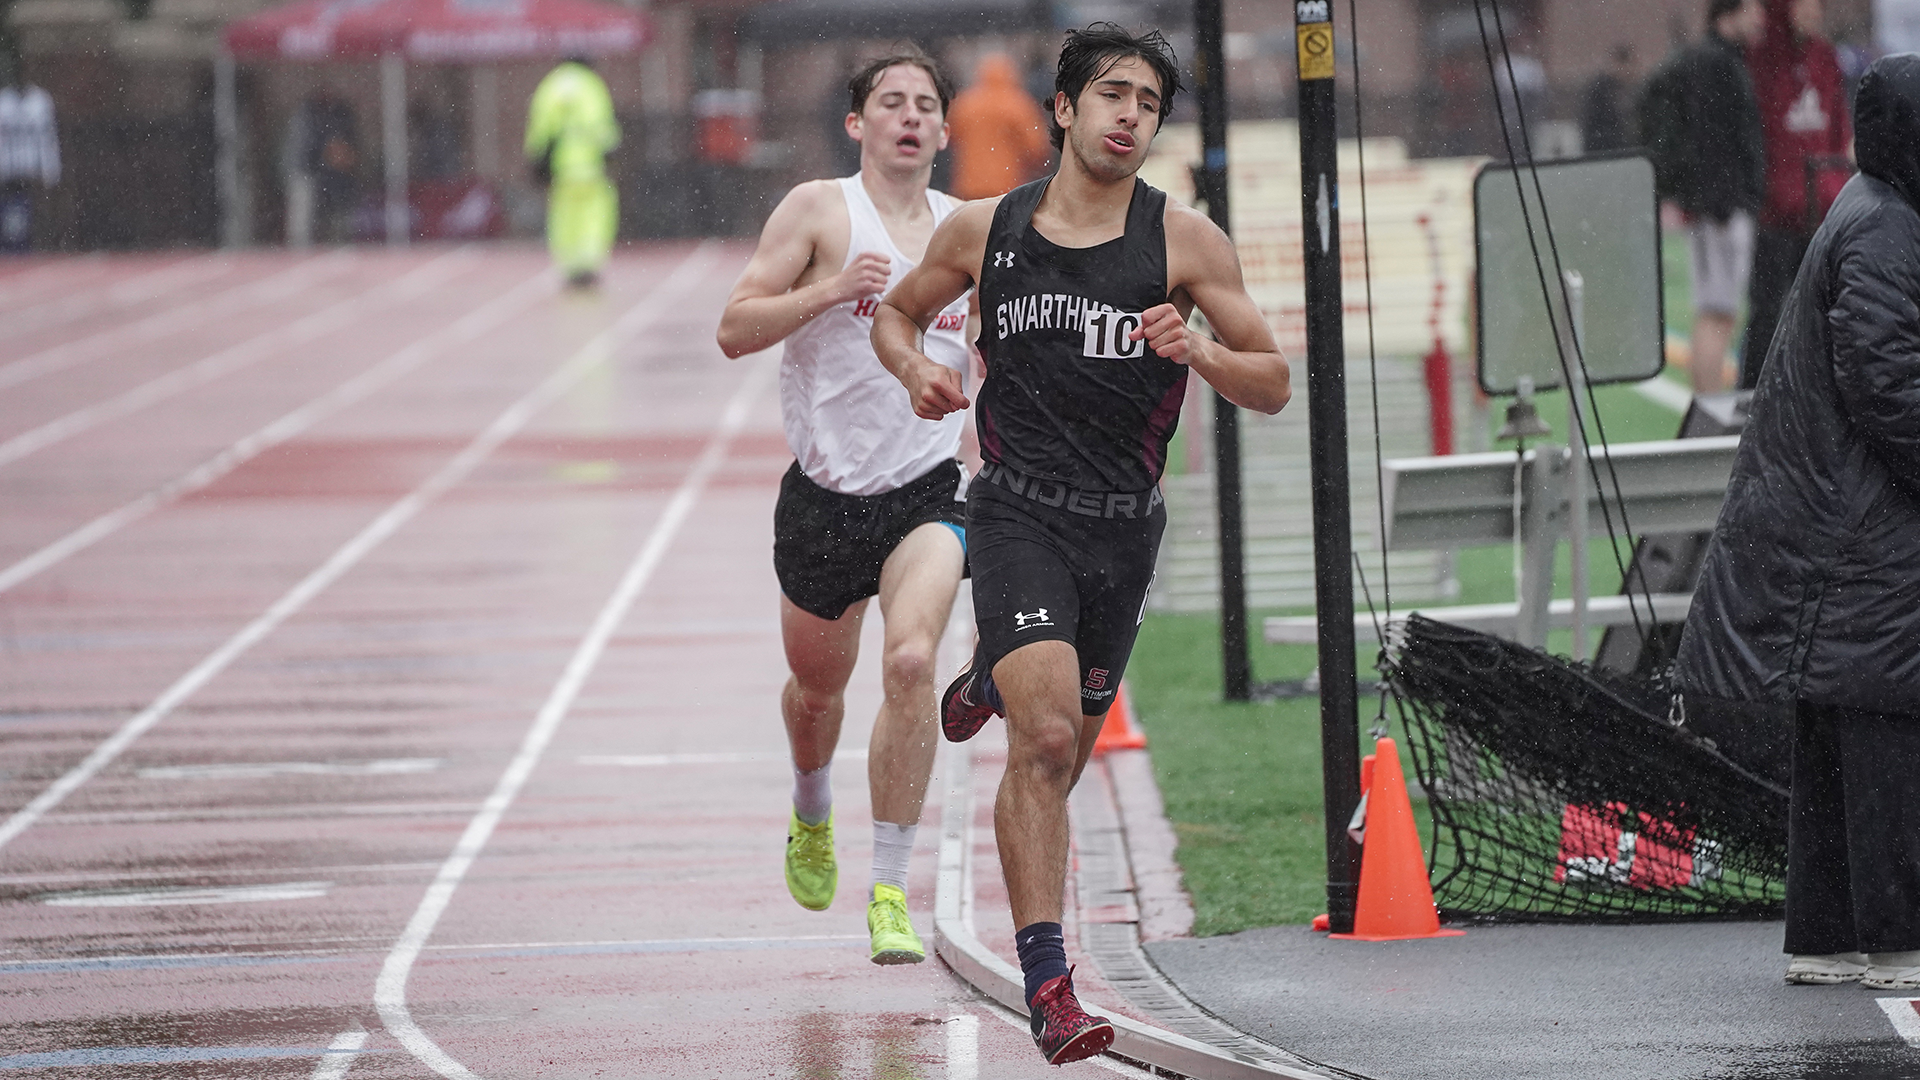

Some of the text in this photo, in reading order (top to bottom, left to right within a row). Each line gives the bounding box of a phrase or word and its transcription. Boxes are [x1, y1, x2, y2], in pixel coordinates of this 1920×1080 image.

[997, 293, 1125, 340] SWARTHM
[1091, 313, 1139, 356] 10
[979, 463, 1137, 519] UNDER
[1085, 667, 1108, 688] S
